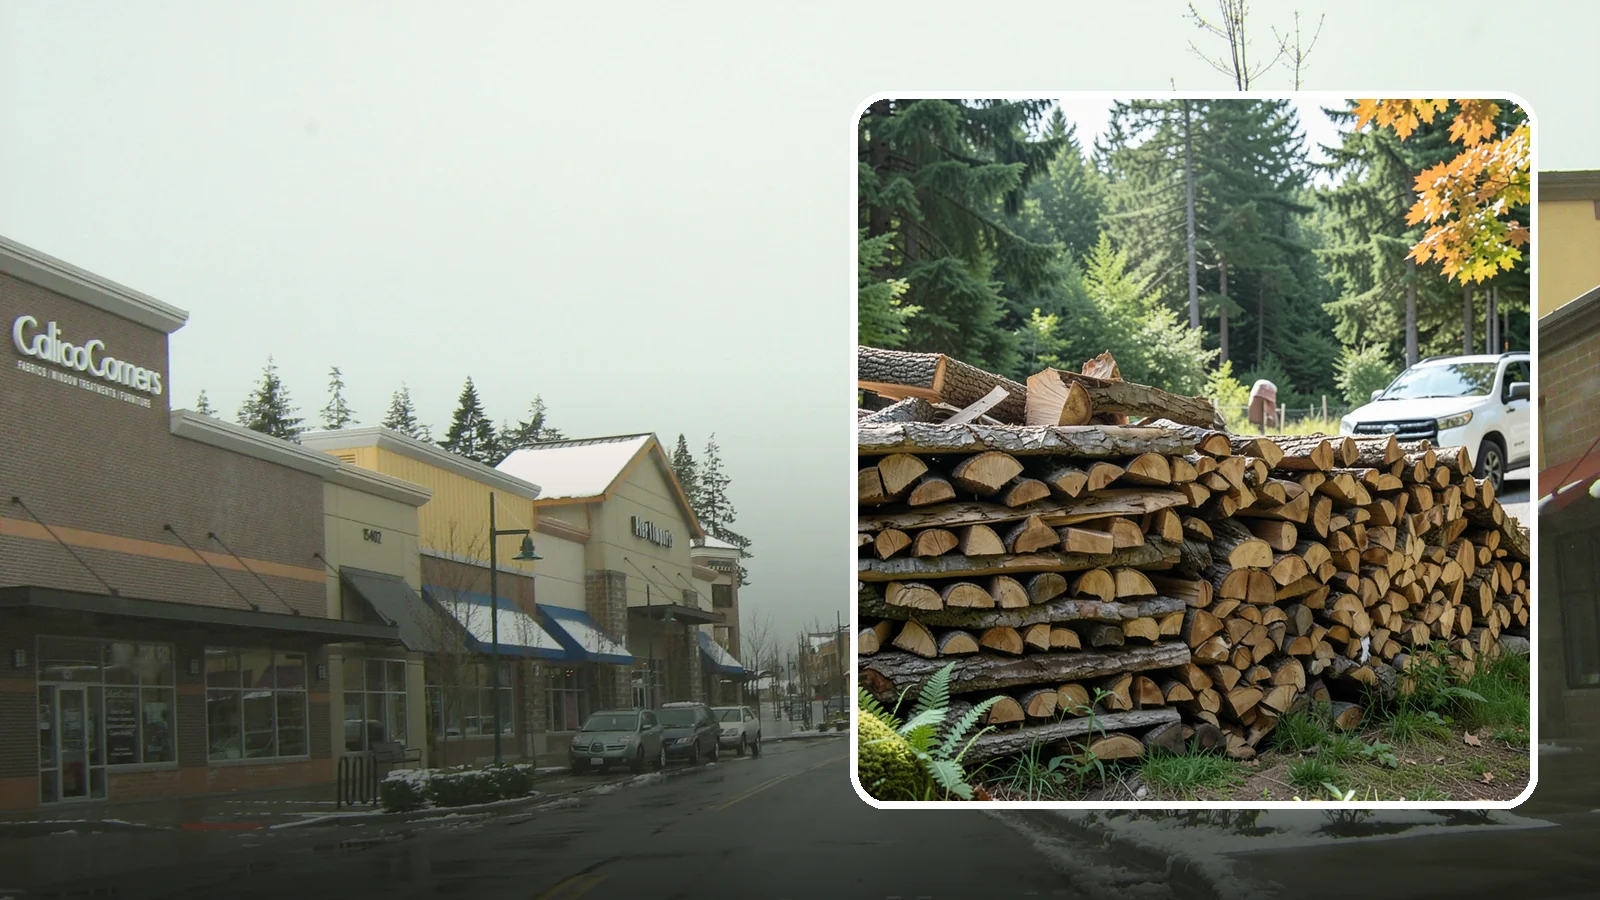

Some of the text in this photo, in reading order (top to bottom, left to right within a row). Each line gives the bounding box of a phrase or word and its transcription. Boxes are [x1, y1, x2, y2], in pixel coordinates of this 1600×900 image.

[17, 360, 151, 408] FABRICS WINDOW TREATMENTS FURNITURE
